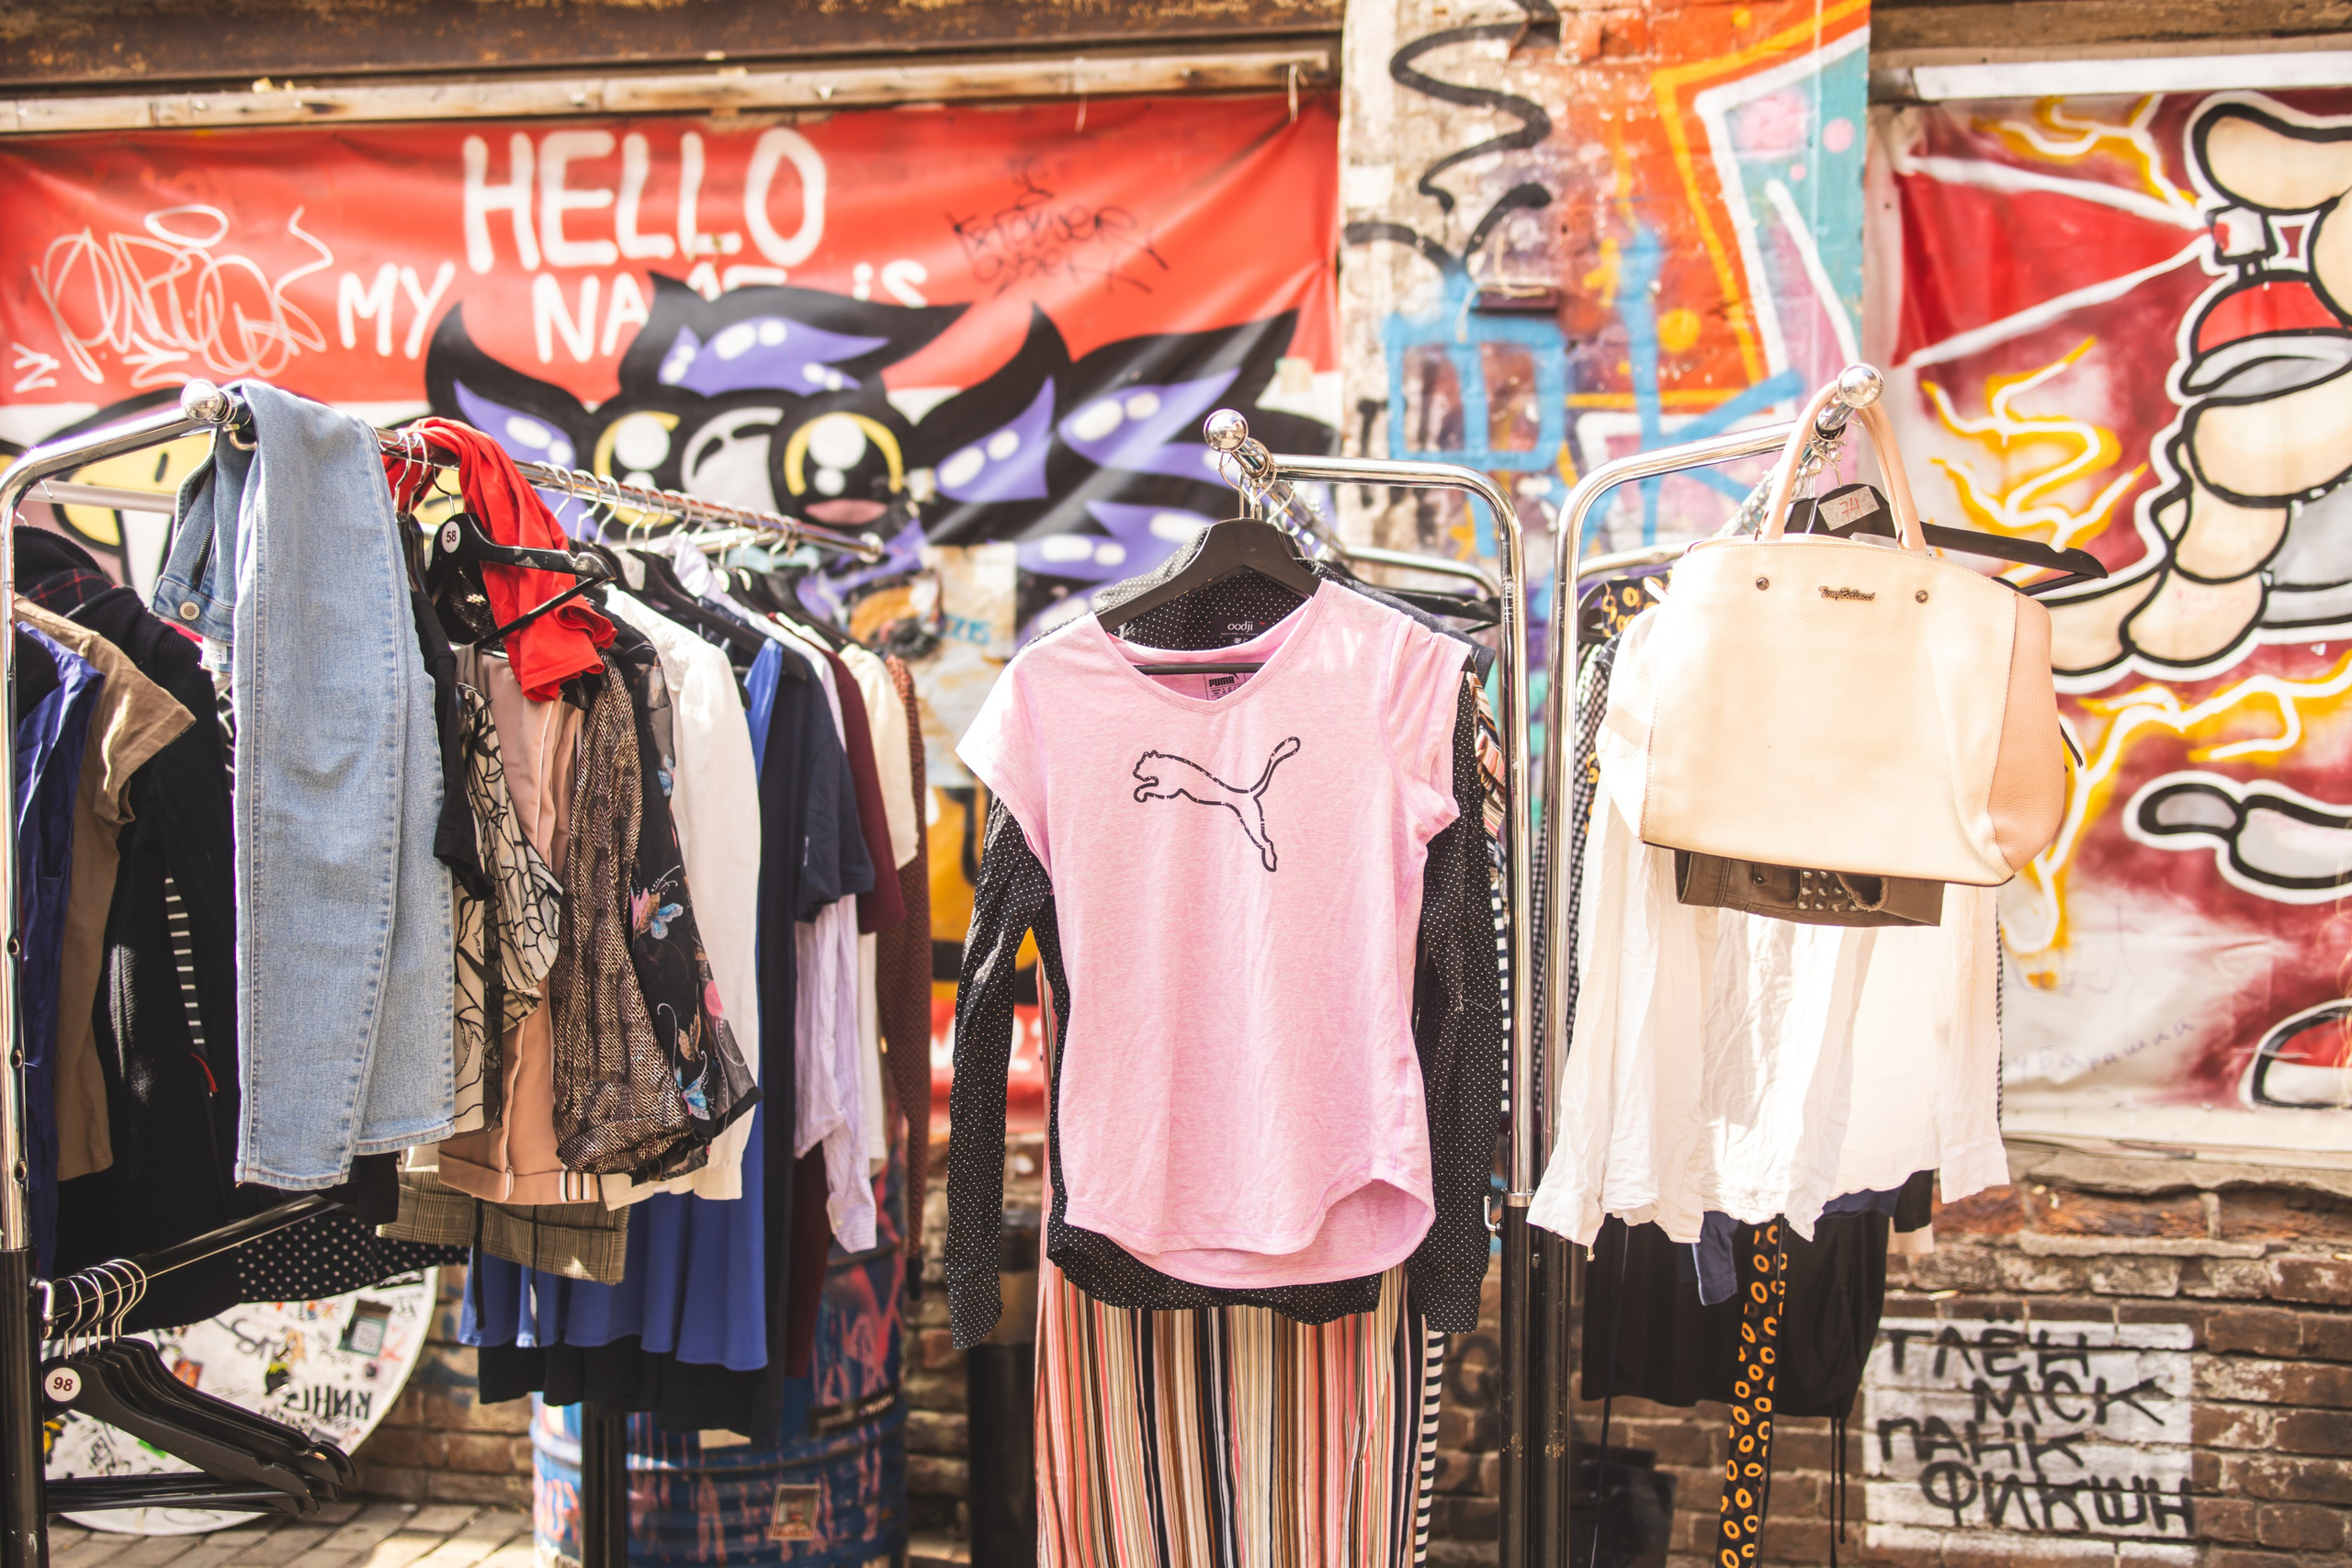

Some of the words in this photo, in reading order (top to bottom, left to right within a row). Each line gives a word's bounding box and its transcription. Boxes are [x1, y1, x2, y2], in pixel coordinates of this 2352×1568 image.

[462, 127, 827, 274] HELLO
[336, 261, 456, 360] MY
[446, 530, 457, 543] 58
[1227, 620, 1253, 633] oodji
[1209, 676, 1235, 687] PUMA
[52, 1376, 74, 1393] 98
[1971, 1369, 2170, 1426] МСК
[1877, 1415, 2086, 1472] ПАНК
[1919, 1461, 2196, 1536] ФИКШН
